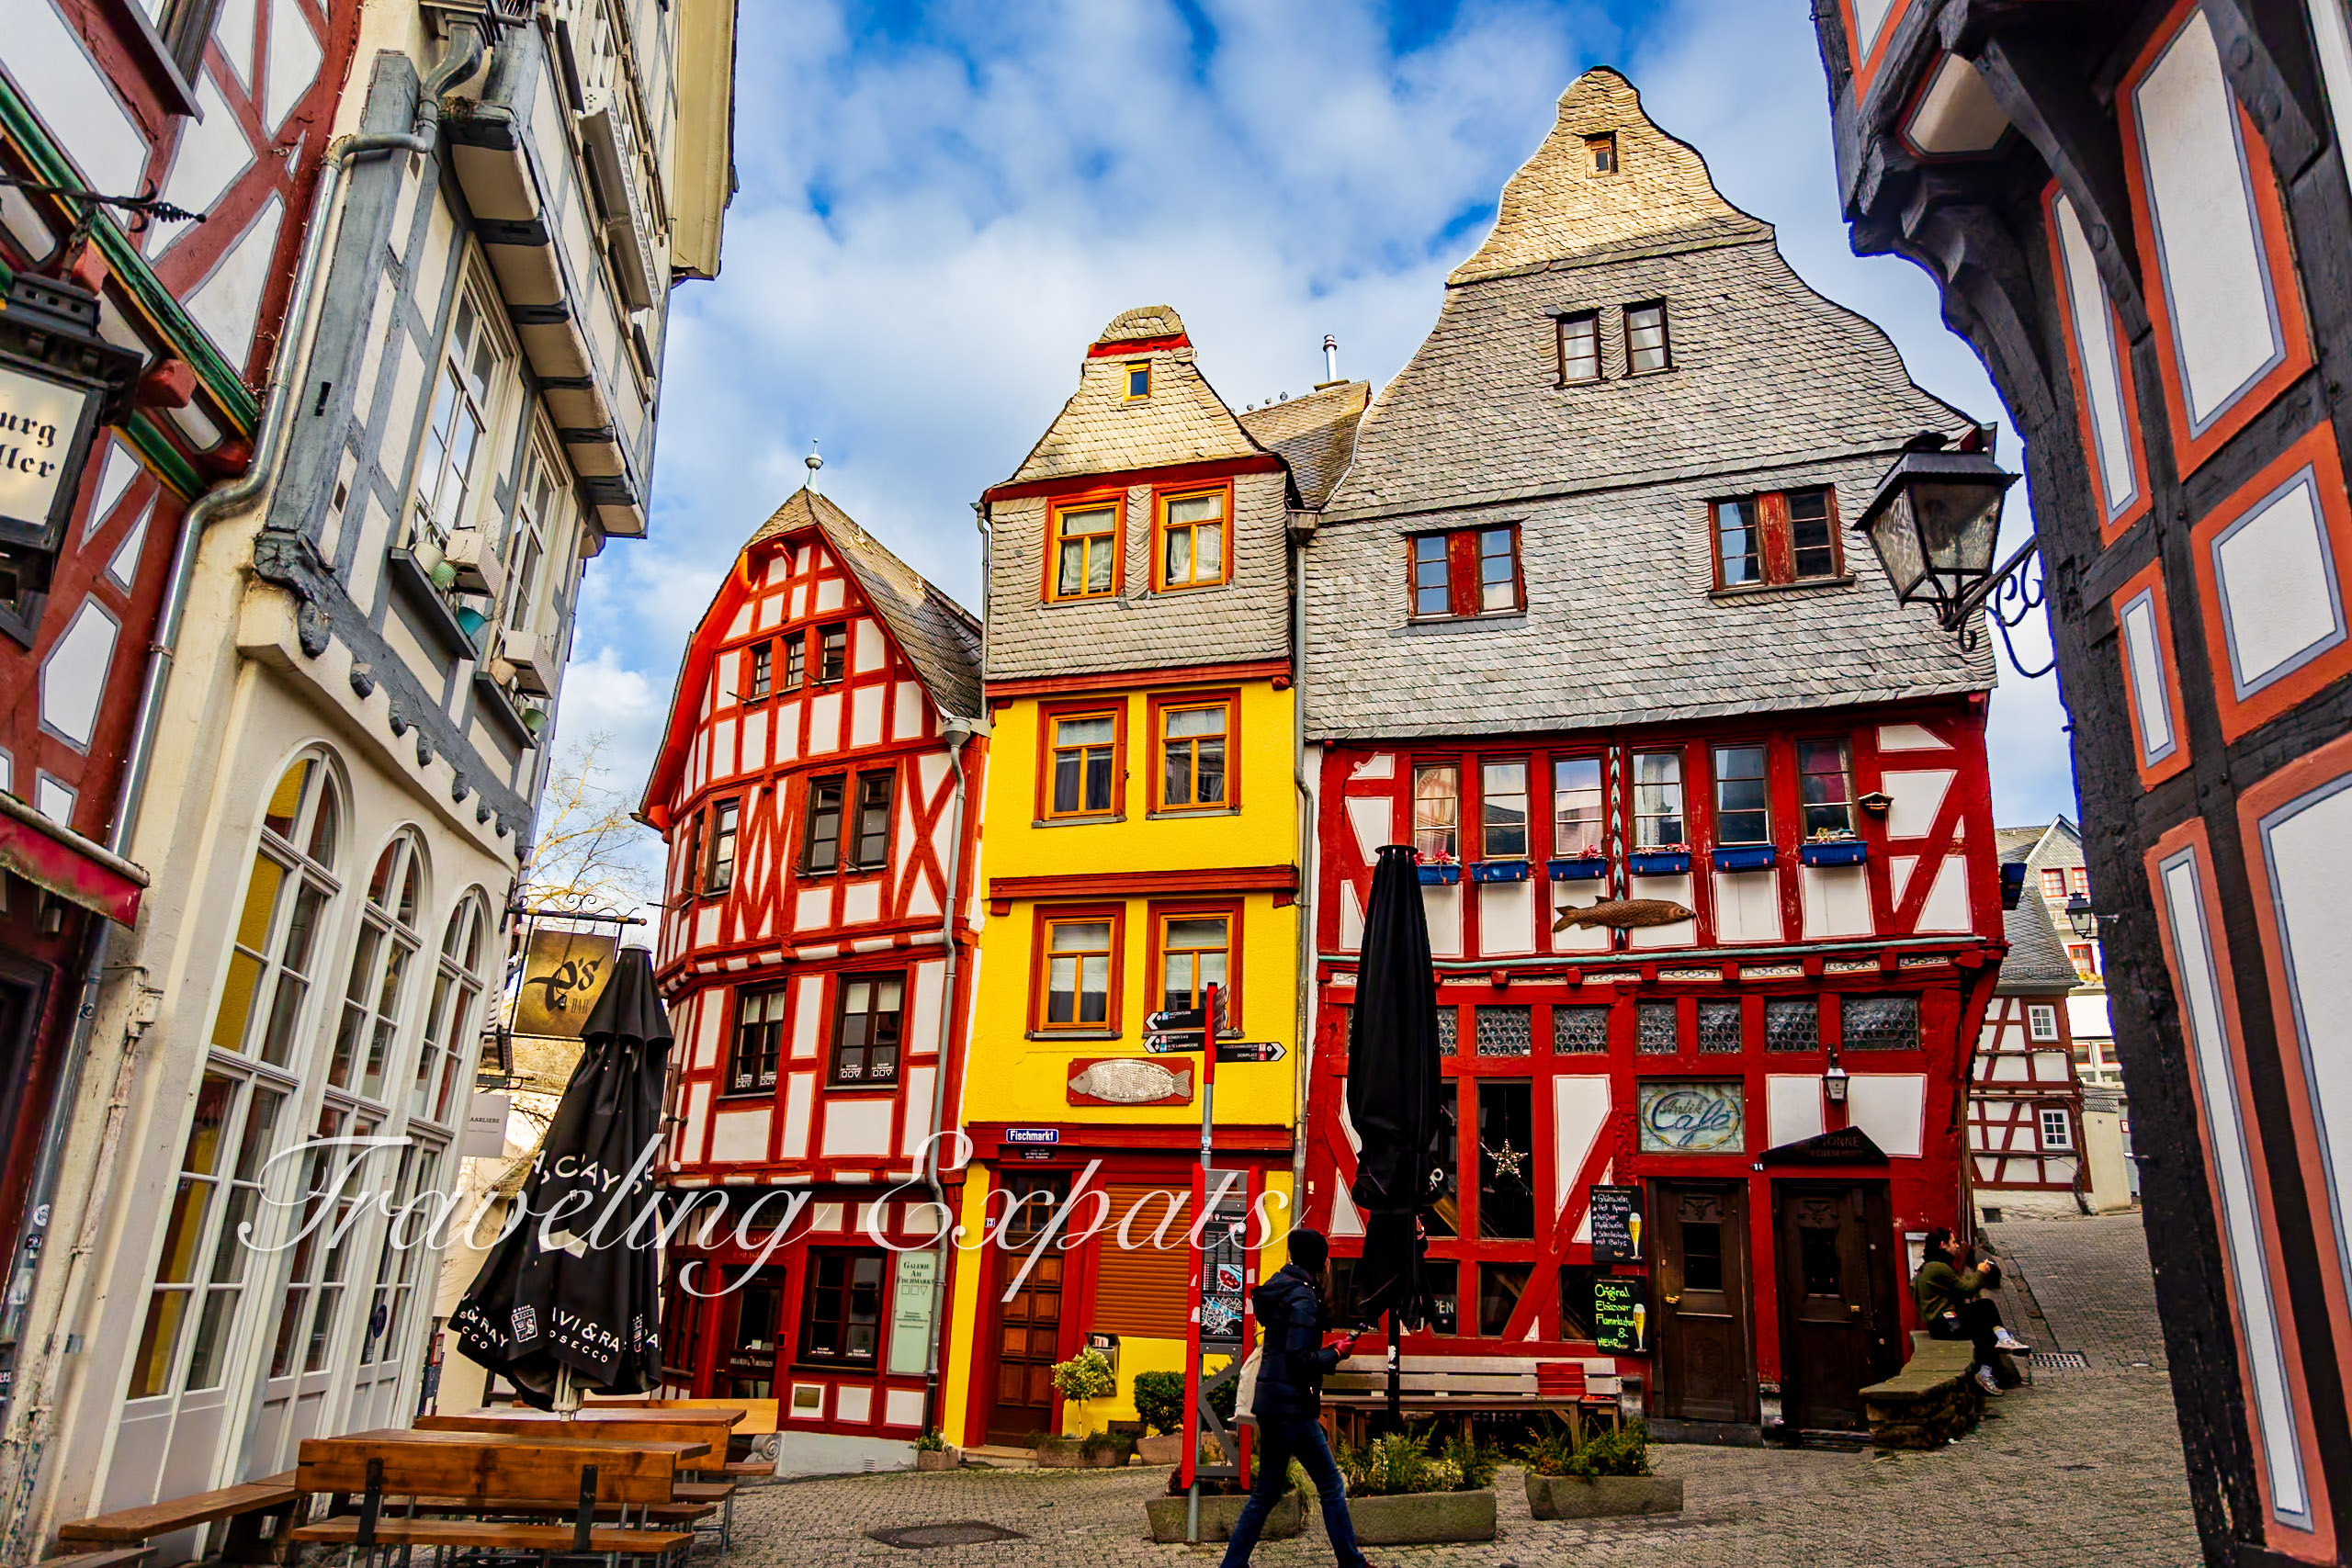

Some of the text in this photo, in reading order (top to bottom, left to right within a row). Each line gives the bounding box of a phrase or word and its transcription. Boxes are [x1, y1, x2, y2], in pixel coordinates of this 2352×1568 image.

[469, 1116, 501, 1124] AARLIEBE
[1010, 1130, 1054, 1141] Fischmarkt
[1434, 1300, 1454, 1314] PEN
